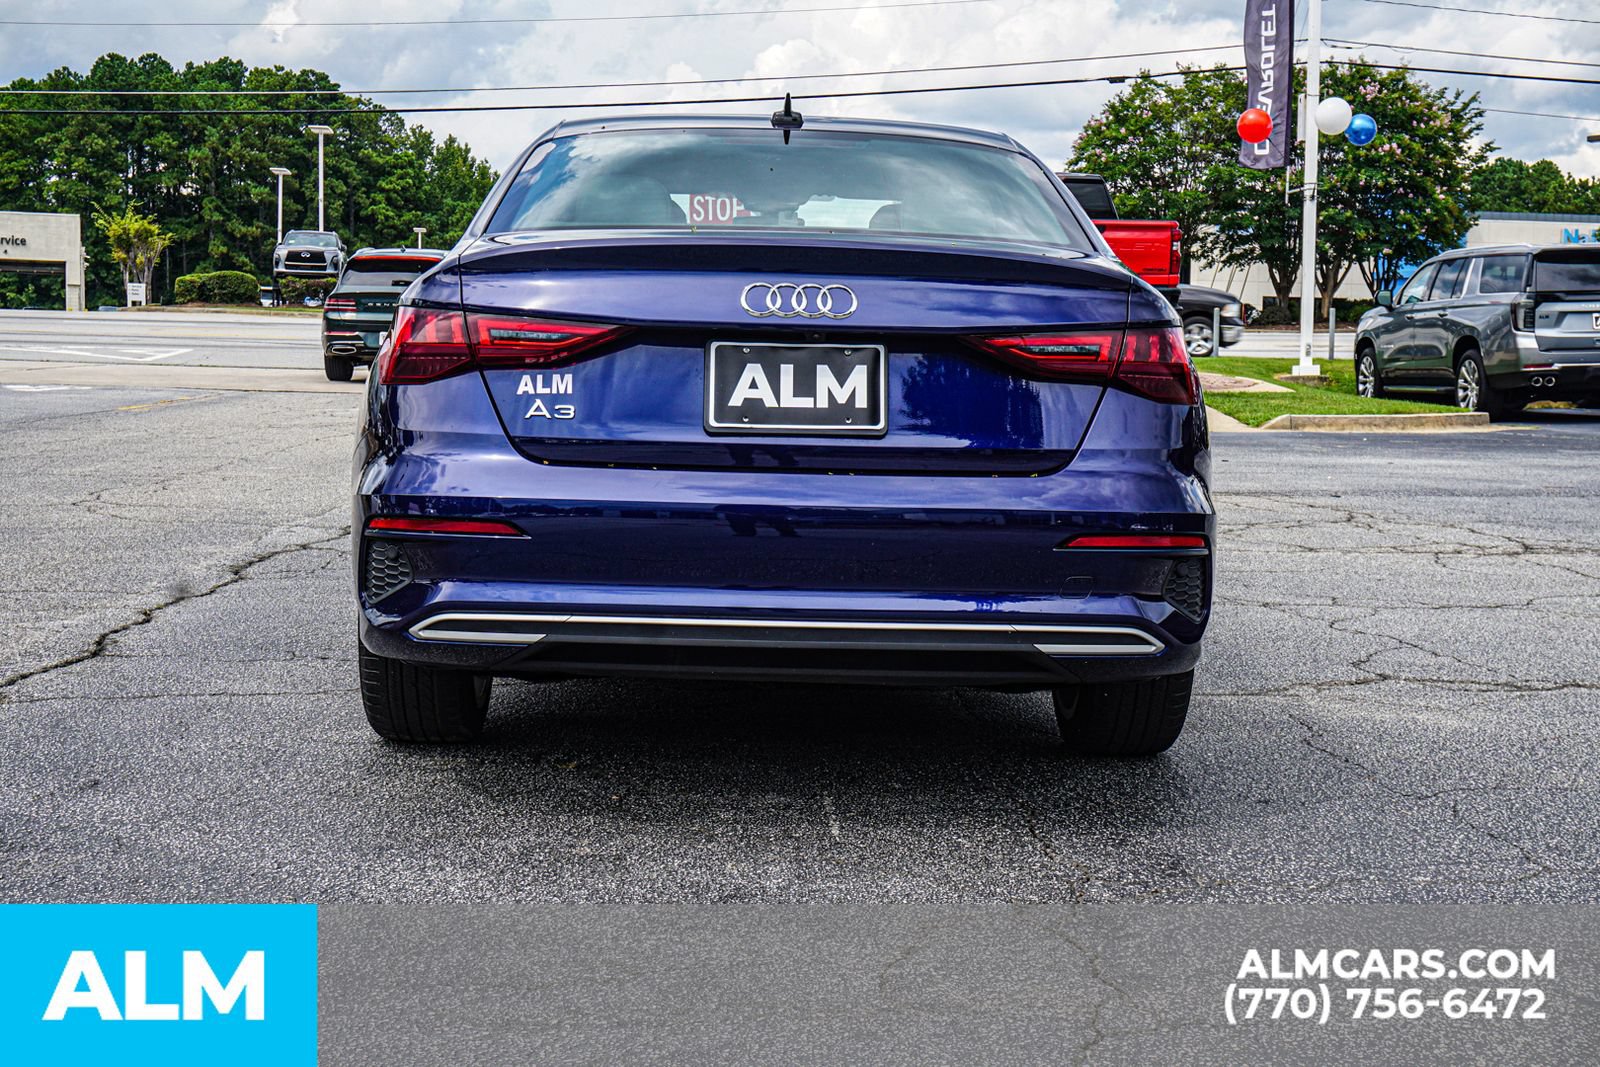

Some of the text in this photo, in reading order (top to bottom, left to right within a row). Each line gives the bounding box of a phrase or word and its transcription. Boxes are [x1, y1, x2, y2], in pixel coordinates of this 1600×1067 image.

[516, 373, 574, 396] ALM
[727, 363, 869, 409] ALM
[523, 398, 577, 420] A3
